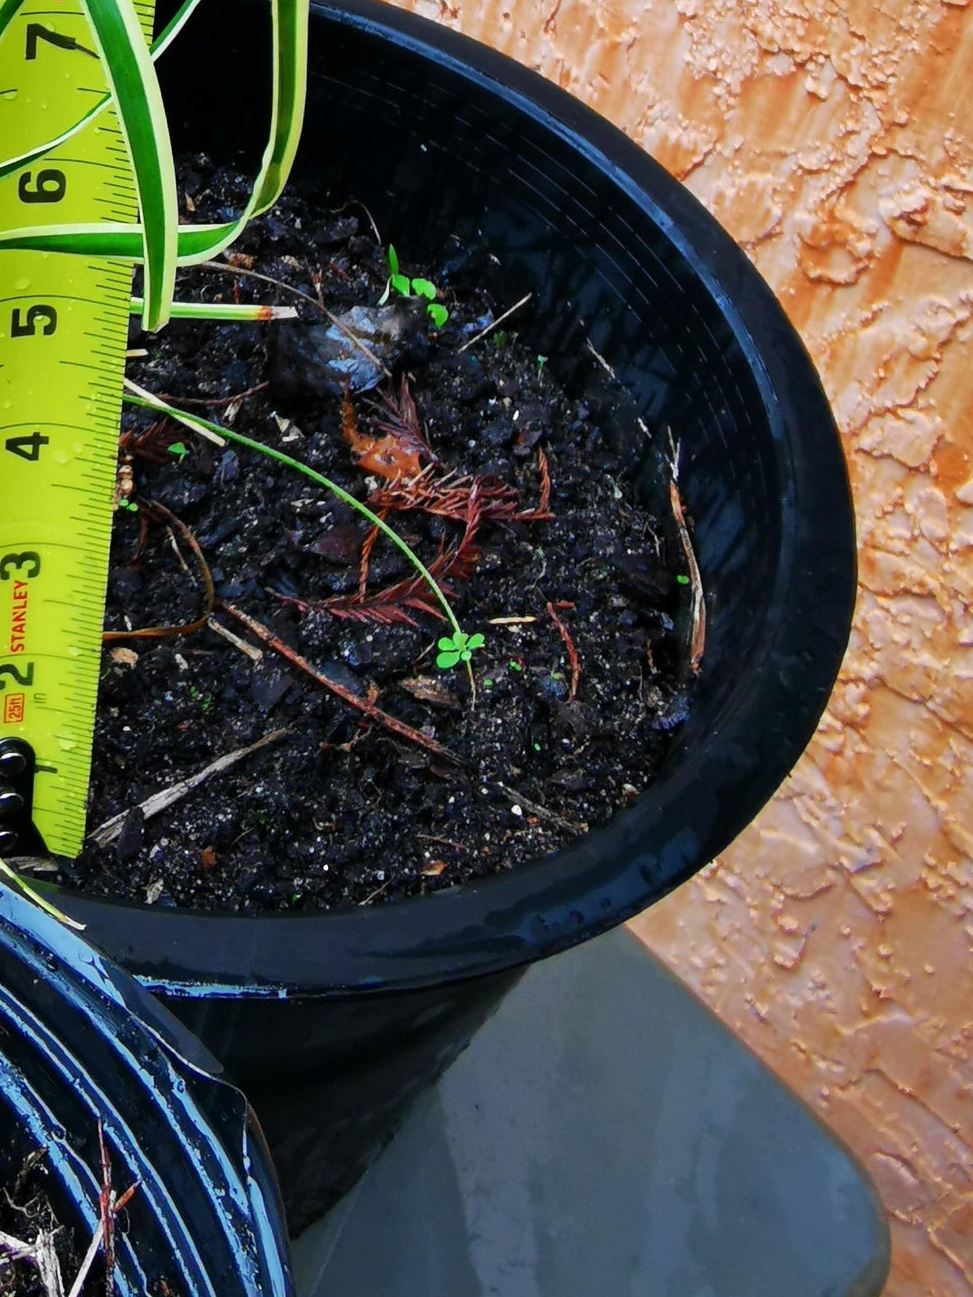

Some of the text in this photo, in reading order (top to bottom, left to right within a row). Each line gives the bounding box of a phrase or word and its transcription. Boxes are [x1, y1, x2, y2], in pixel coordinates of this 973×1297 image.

[25, 23, 76, 60] 7
[18, 168, 67, 204] 6
[10, 304, 58, 338] 5
[5, 431, 50, 462] 4
[0, 550, 41, 581] 3
[10, 580, 28, 653] STANLEY
[8, 697, 23, 719] 25ft
